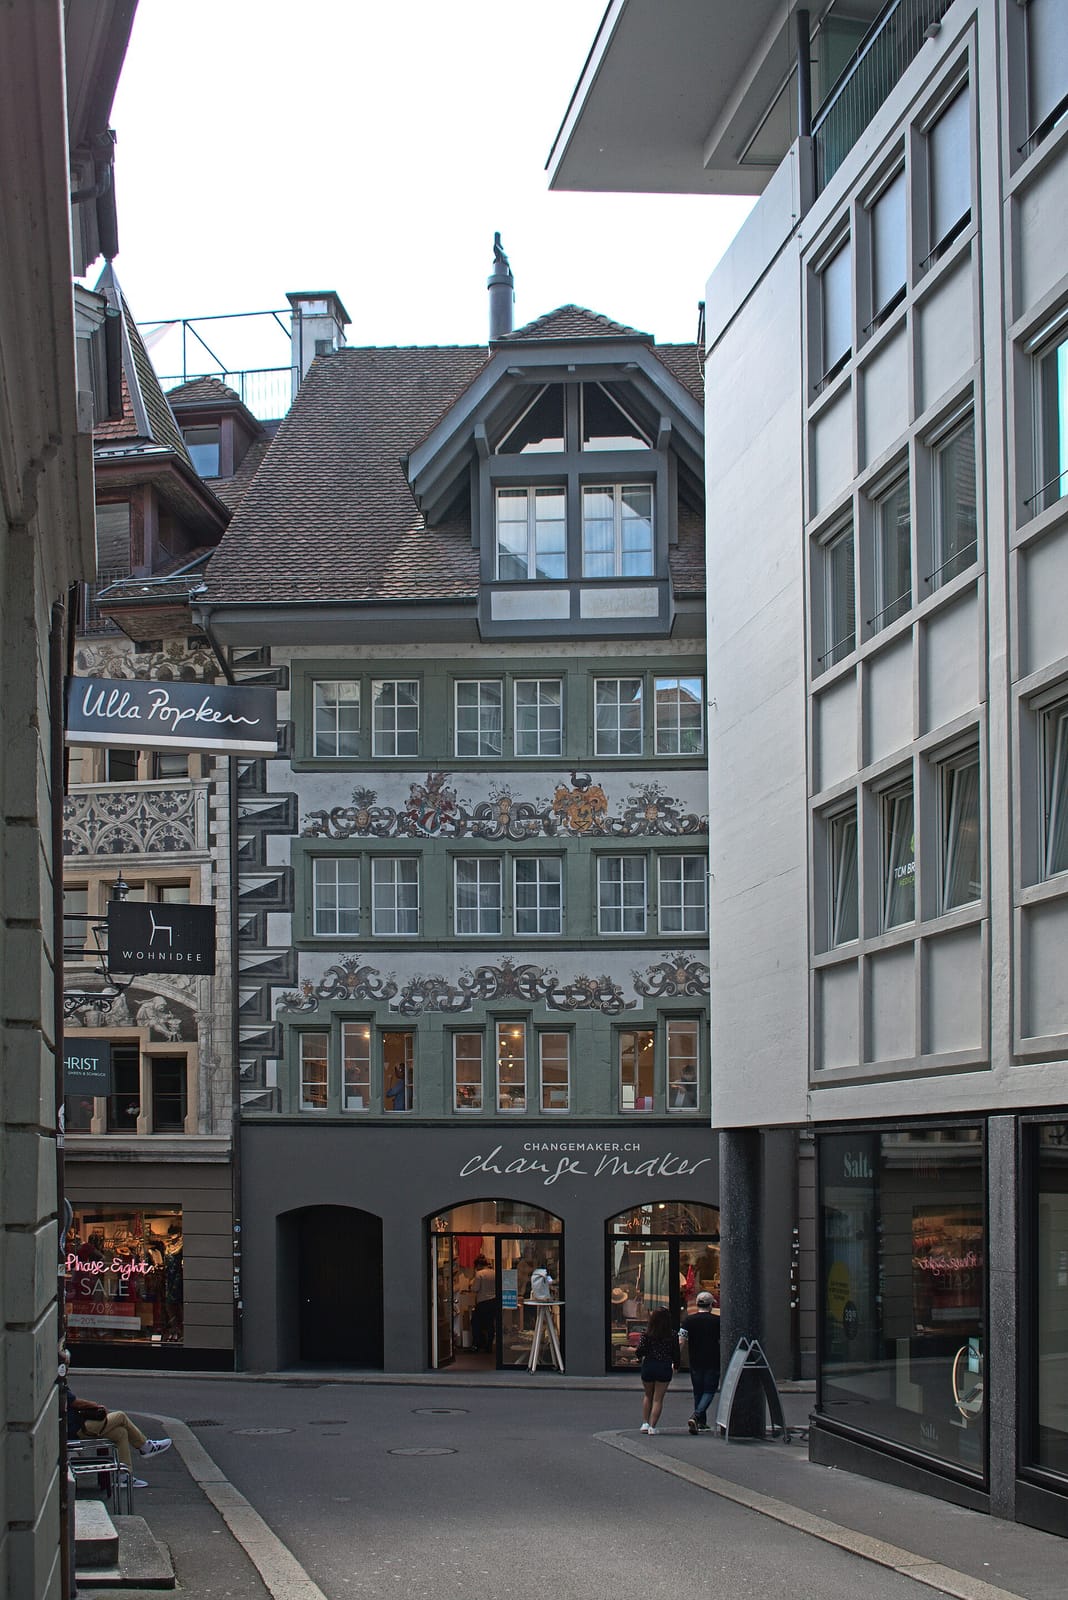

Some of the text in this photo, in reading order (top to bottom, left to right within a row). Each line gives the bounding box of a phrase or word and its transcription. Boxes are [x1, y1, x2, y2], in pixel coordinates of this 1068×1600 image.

[82, 684, 260, 732] Ulla Popken
[122, 950, 203, 962] WOHNIDEE
[63, 1056, 100, 1071] HRIST
[523, 1142, 641, 1151] CHANGEMAKER.CH
[459, 1145, 588, 1185] change
[65, 1253, 152, 1281] Phase Eight
[80, 1278, 130, 1297] SALE
[88, 1302, 114, 1314] 70%
